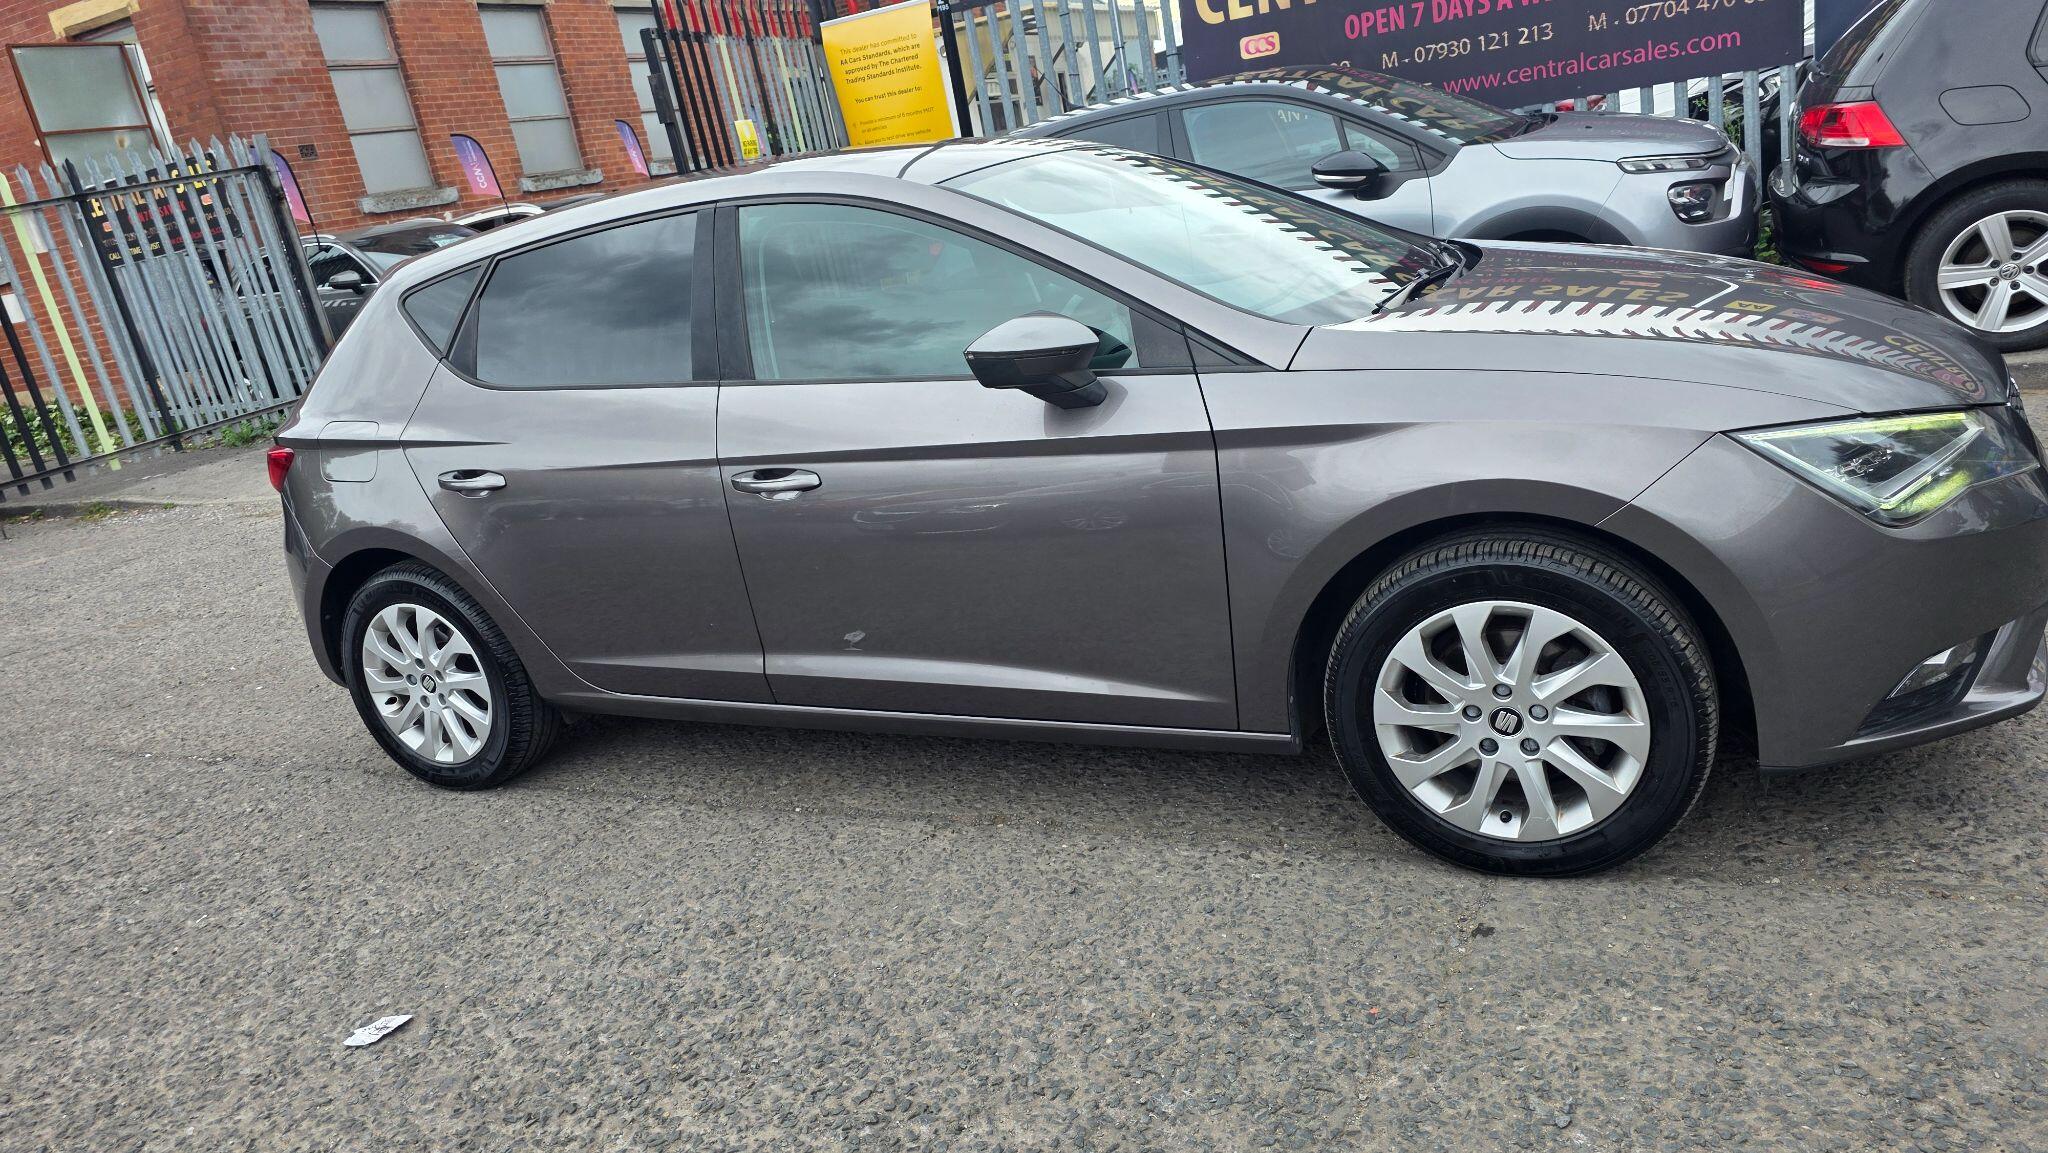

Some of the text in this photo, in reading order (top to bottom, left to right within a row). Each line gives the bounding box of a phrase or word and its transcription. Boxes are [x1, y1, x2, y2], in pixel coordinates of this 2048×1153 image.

[1196, 0, 1318, 25] CE
[1344, 4, 1405, 40] OPEN
[1411, 2, 1424, 28] 7
[1432, 0, 1492, 24] DAYS
[1587, 12, 1608, 32] M
[1625, 0, 1690, 26] 07704
[840, 48, 852, 56] This
[852, 45, 869, 53] dealer
[880, 34, 910, 47] committed
[840, 58, 849, 66] AA
[849, 56, 862, 64] Cars
[893, 45, 910, 54] which
[1244, 35, 1276, 56] CCS
[1381, 51, 1399, 70] M
[1414, 37, 1471, 63] 07930
[1478, 31, 1509, 52] 121
[1518, 22, 1555, 45] 213
[844, 63, 871, 76] approved
[871, 62, 878, 70] by
[890, 53, 919, 65] Chartered
[1442, 30, 1743, 95] www.centralcarsales.com
[846, 75, 866, 84] Trading
[866, 69, 895, 81] Standards
[887, 89, 897, 97] this
[897, 86, 914, 95] dealer
